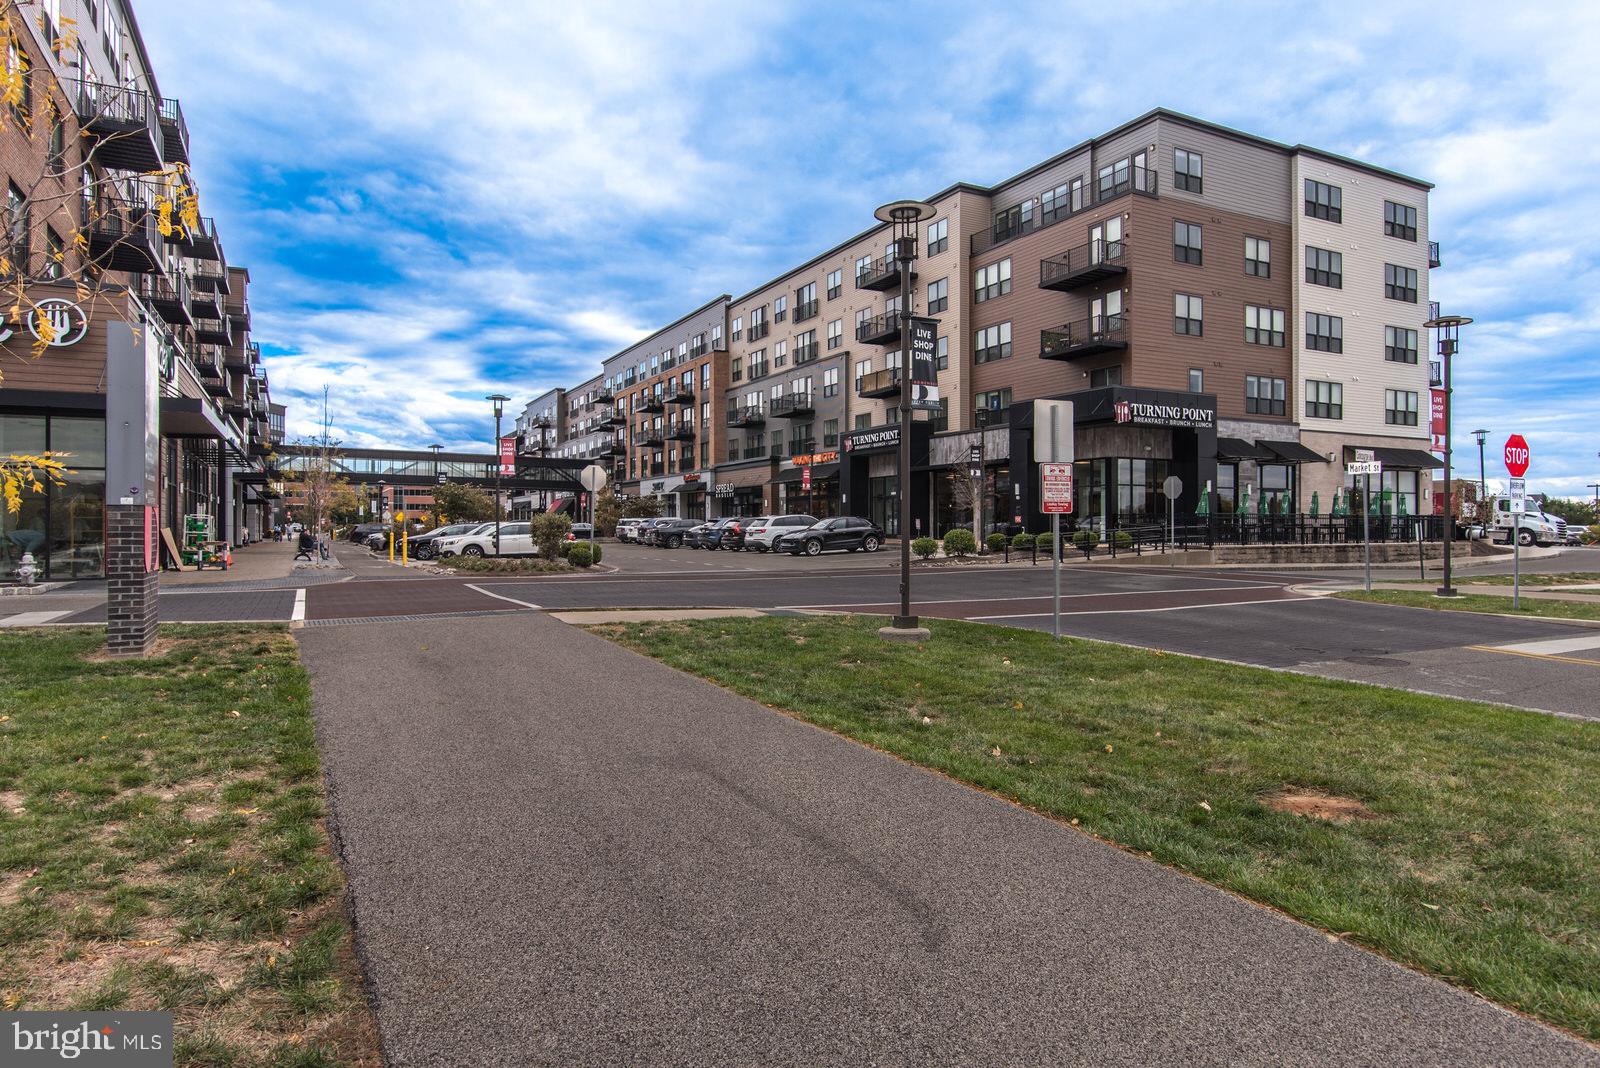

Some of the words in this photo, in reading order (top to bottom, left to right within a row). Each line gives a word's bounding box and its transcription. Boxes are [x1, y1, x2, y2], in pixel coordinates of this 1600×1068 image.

[916, 328, 931, 339] LIVE
[913, 339, 934, 350] SHOP
[915, 351, 932, 362] DINE
[1433, 396, 1443, 404] LIVE
[1130, 403, 1181, 419] TURNING
[1182, 407, 1214, 422] POINT
[1133, 416, 1164, 425] BREAKFAST
[1169, 419, 1191, 427] BRUNCH
[853, 433, 878, 445] TURNING
[880, 430, 898, 441] POINT
[1505, 447, 1528, 465] STOP
[1349, 464, 1371, 473] Market
[1373, 464, 1380, 472] St
[716, 483, 734, 493] SPREAD
